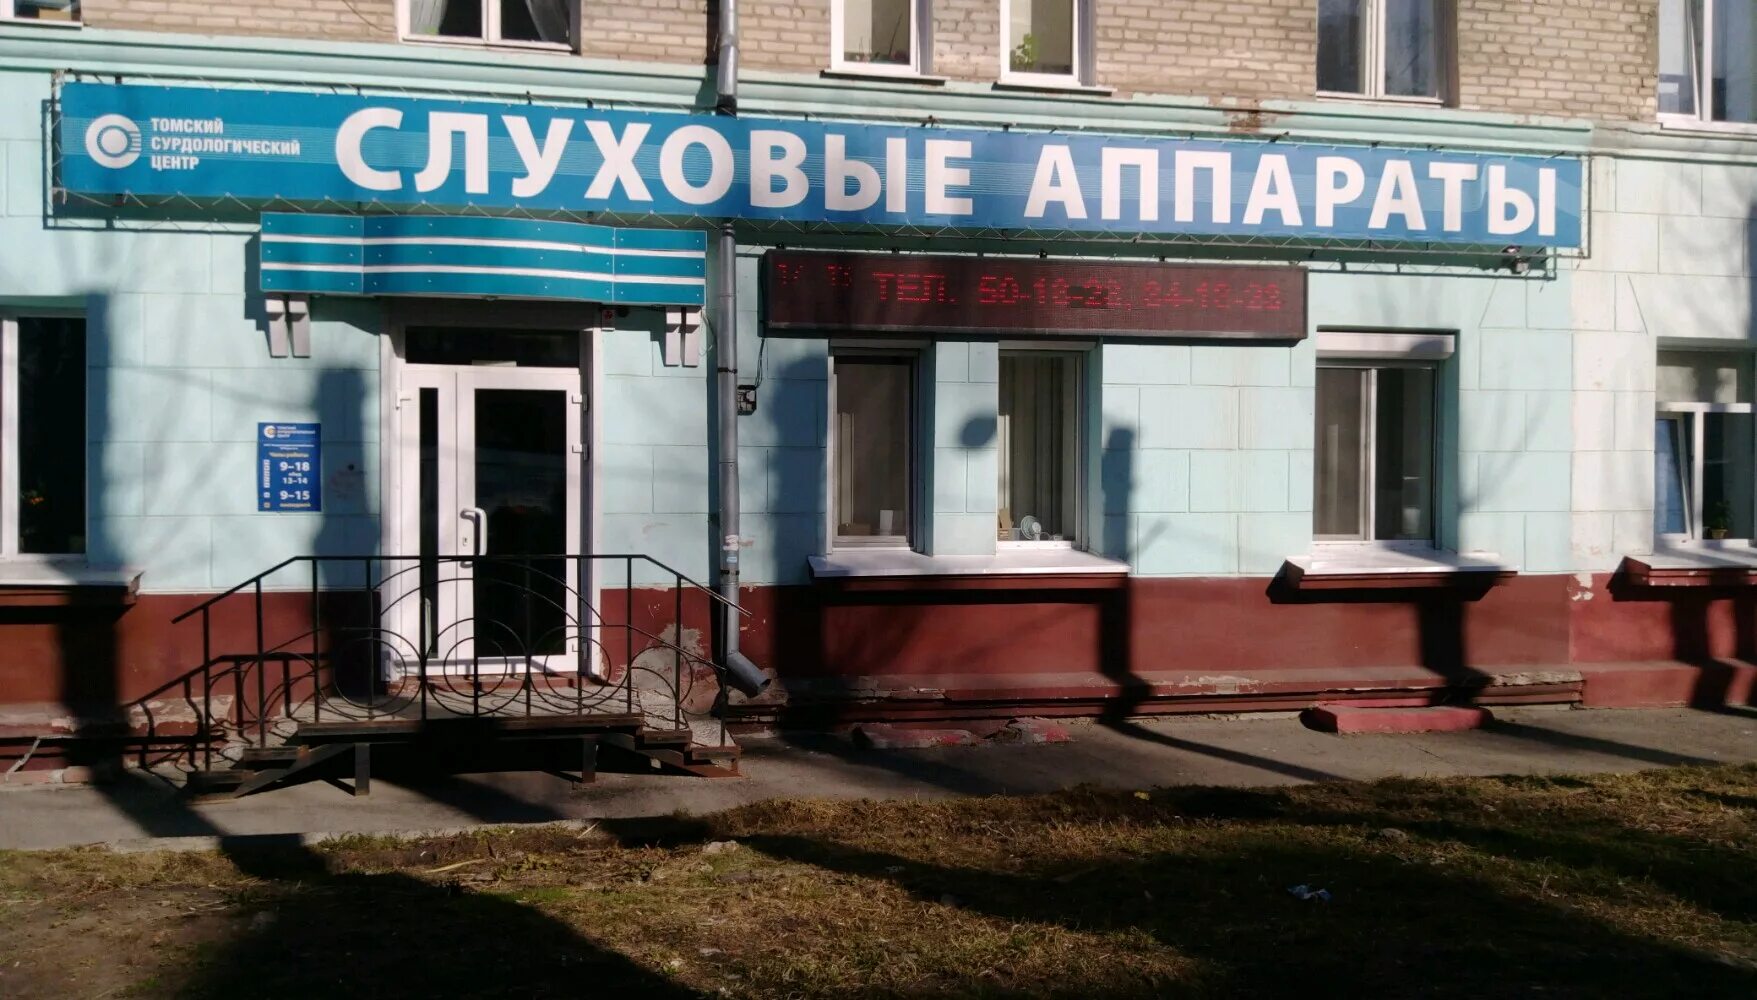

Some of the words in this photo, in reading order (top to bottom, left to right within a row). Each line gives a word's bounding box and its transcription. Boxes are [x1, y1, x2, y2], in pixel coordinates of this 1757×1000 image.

[151, 117, 224, 134] ТОМСКИЙ
[151, 136, 301, 155] СУРДОЛОГИЧЕСКИЙ
[151, 156, 200, 171] ЦЕНТР
[335, 107, 974, 216] СЛУХОВЫЕ
[1024, 144, 1556, 237] АППАРАТЫ
